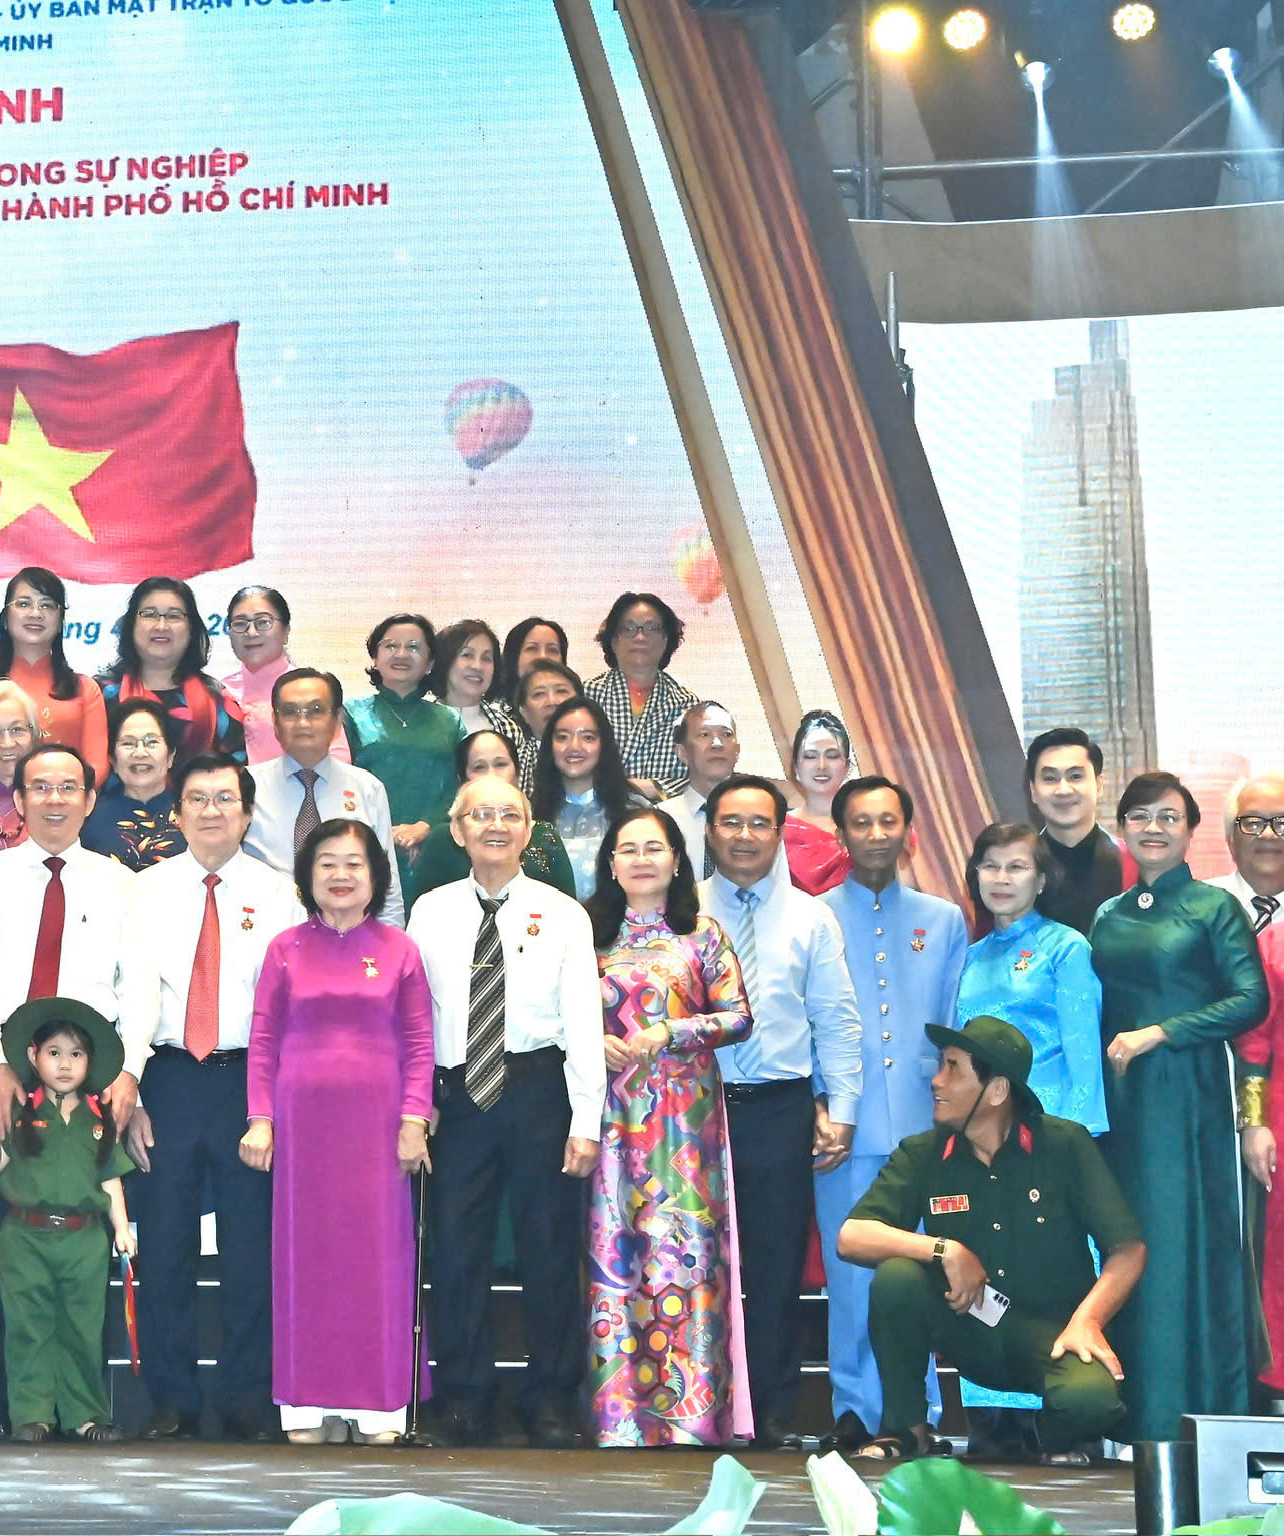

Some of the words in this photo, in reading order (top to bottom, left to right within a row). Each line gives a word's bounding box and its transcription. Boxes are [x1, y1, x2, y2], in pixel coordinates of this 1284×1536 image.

[50, 0, 99, 17] BAN
[75, 156, 120, 188] SỰ
[127, 147, 248, 180] NGHIỆP
[104, 183, 172, 216] PHỐ
[182, 179, 229, 213] HỒ
[239, 181, 295, 211] CHÍ
[305, 183, 389, 208] MINH
